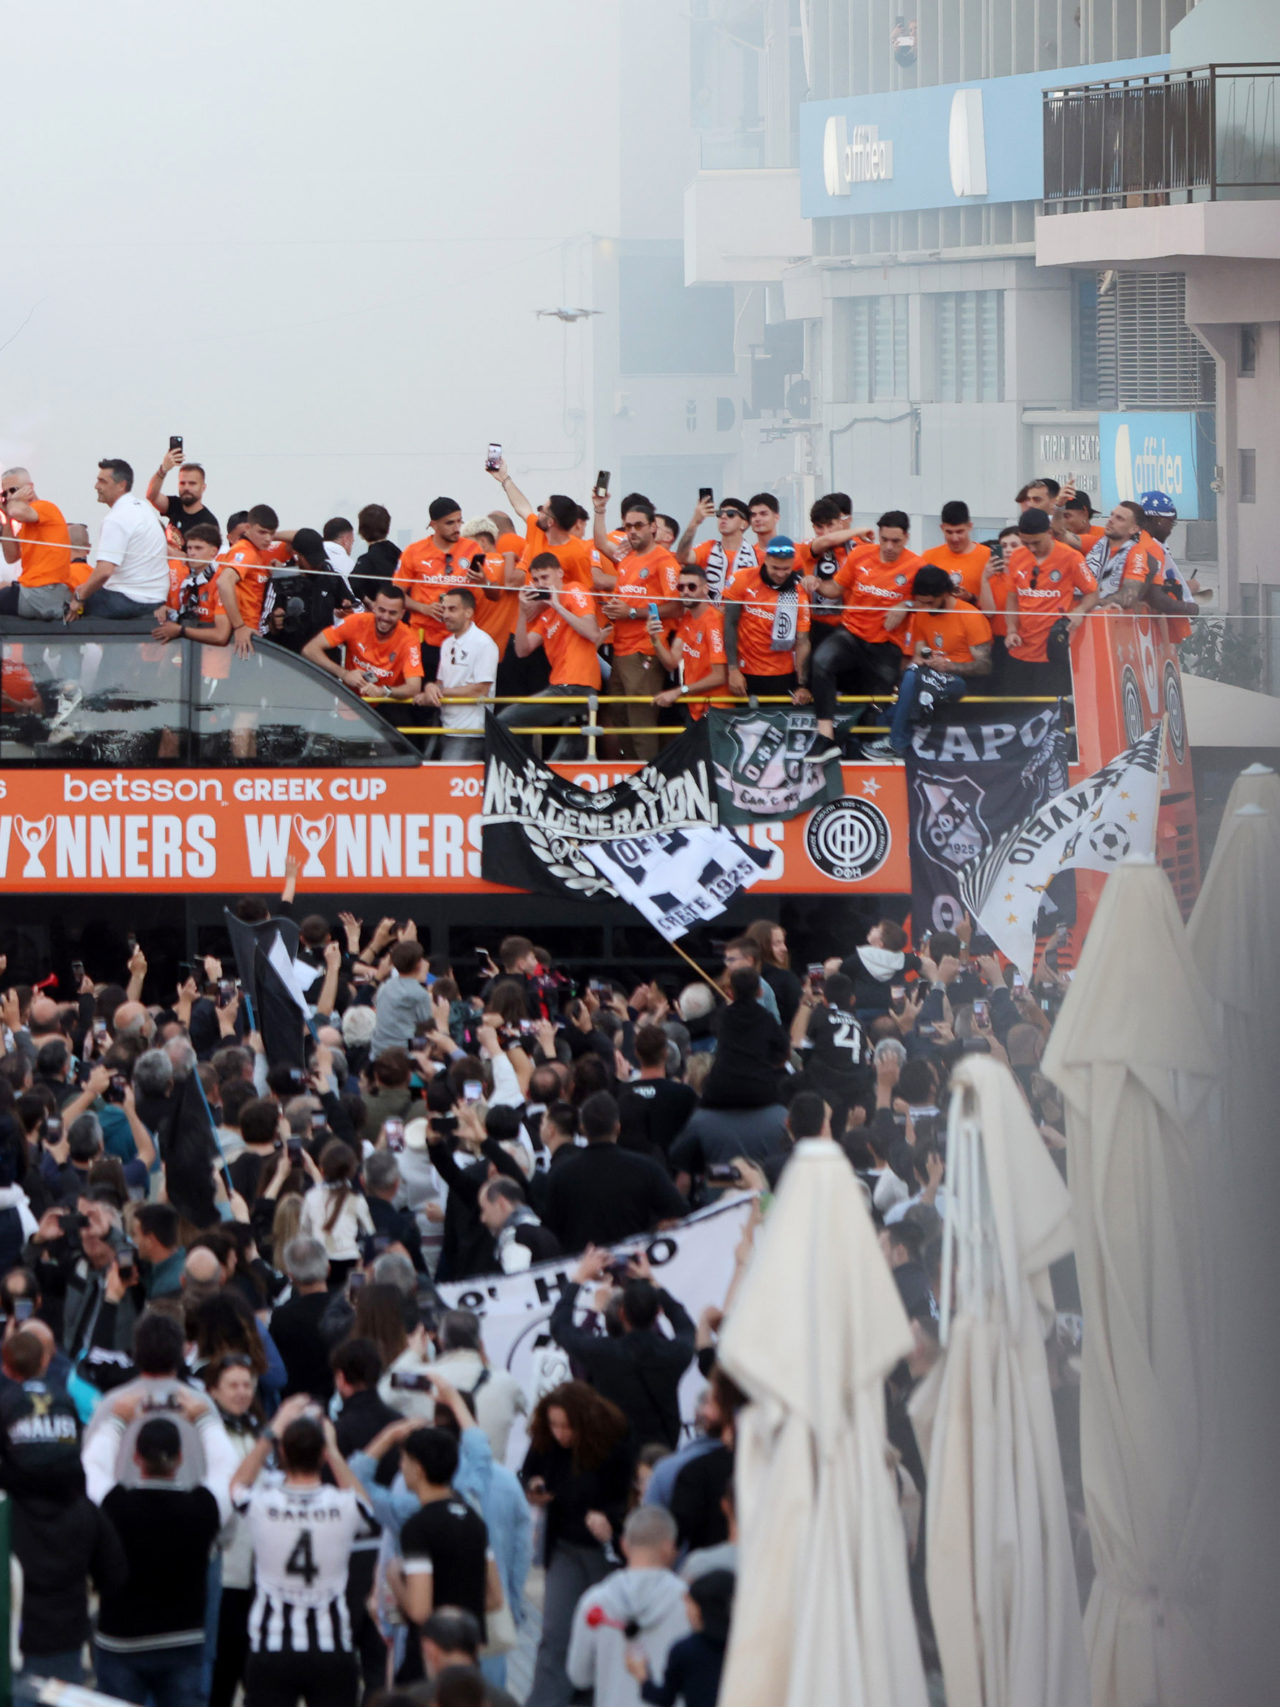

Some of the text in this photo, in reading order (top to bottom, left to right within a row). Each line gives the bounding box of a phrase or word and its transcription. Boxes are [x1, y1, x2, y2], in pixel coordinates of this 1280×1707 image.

[845, 125, 888, 182] affidea
[1135, 436, 1183, 495] affidea
[857, 583, 903, 598] betsson
[1017, 587, 1061, 598] betsson
[744, 603, 775, 621] betss
[352, 655, 394, 677] betsson
[64, 773, 386, 802] betsson GREEK CUP
[949, 843, 976, 856] 1925
[832, 866, 863, 880] ΟΦΗ
[656, 860, 755, 931] CRETE 1925
[833, 1024, 861, 1064] 4
[284, 1529, 319, 1587] 4
